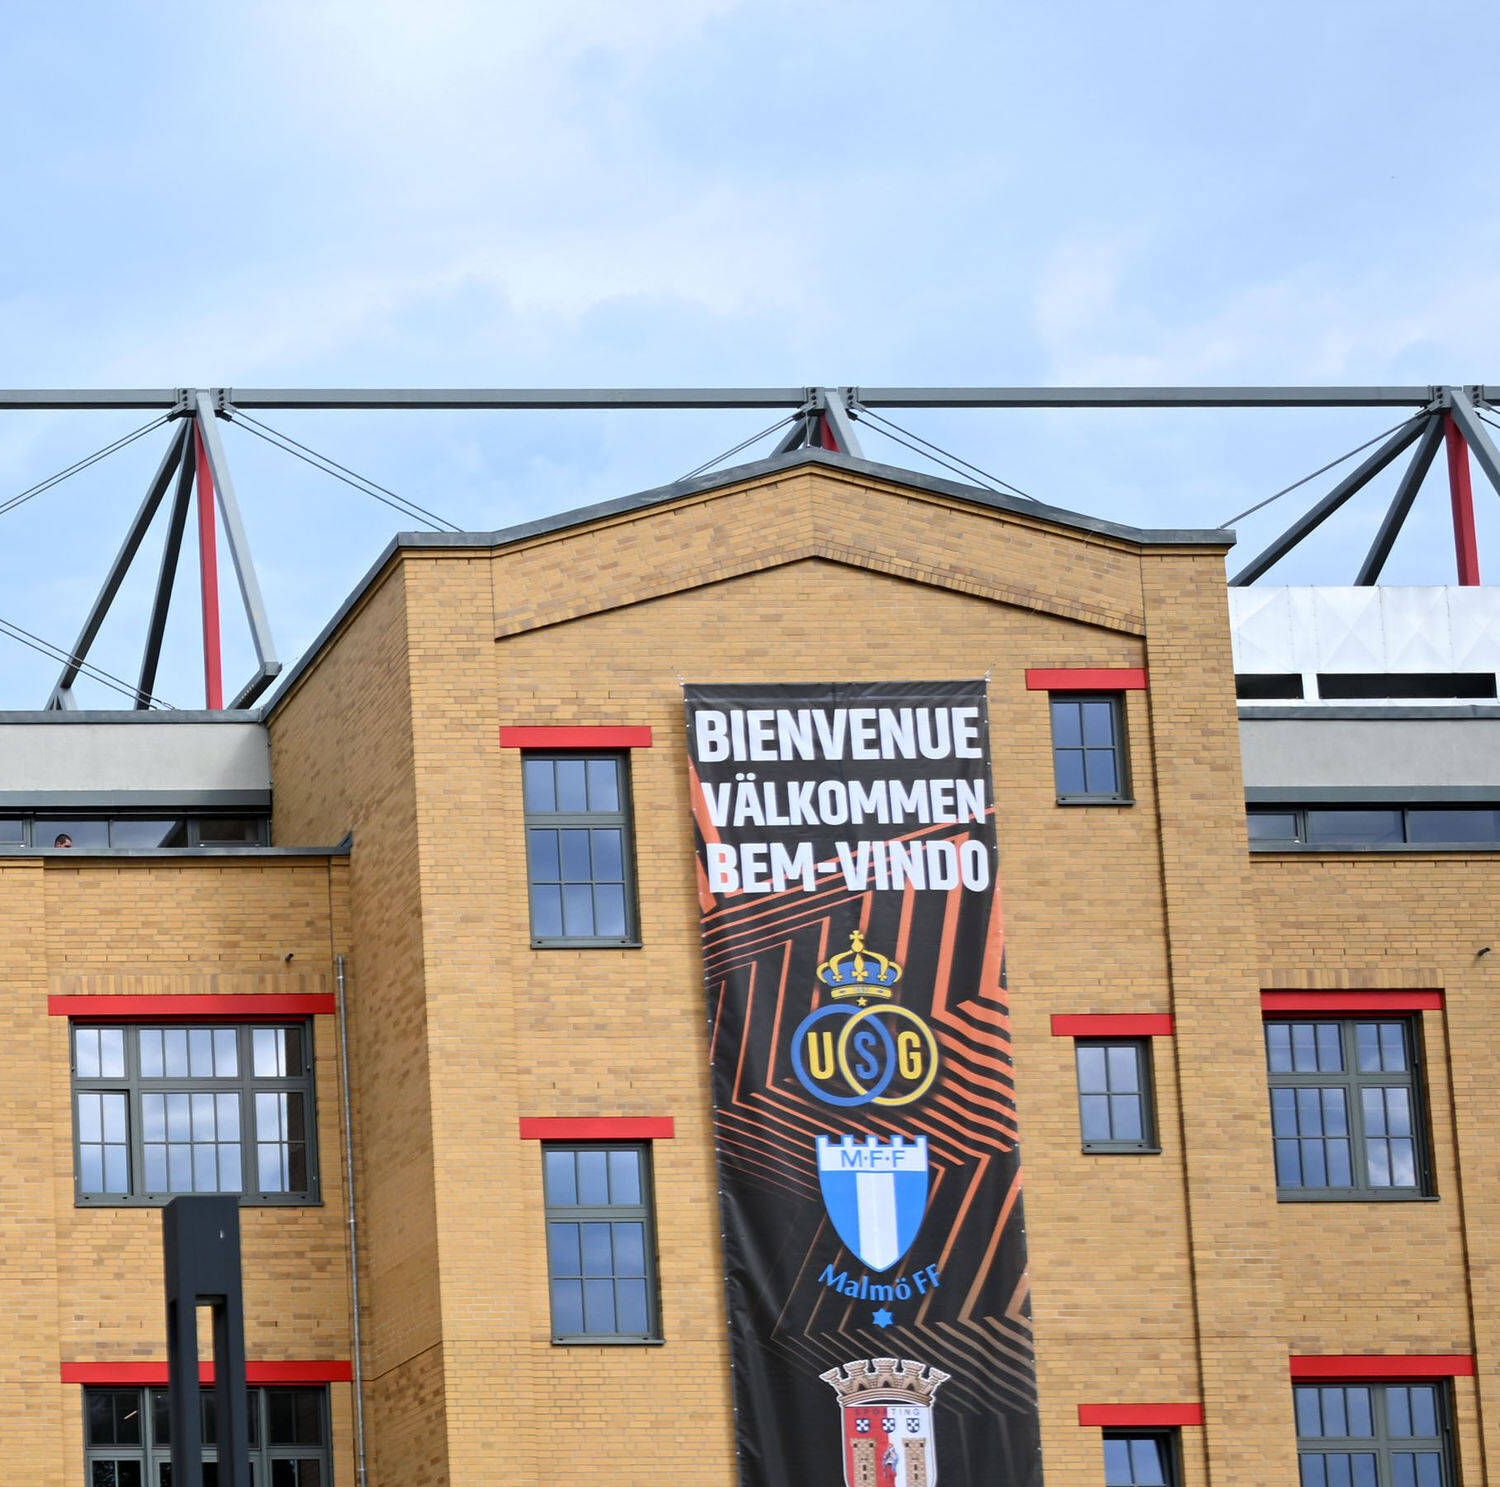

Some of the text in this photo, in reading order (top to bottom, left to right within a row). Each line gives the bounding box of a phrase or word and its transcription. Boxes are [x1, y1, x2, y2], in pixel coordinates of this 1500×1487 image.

[694, 707, 983, 762] BIENVENUE
[700, 772, 987, 828] VÄLKOMMEN
[705, 838, 990, 893] BEM-VINDO
[806, 1030, 923, 1080] USG
[818, 1263, 943, 1302] Malmö FF
